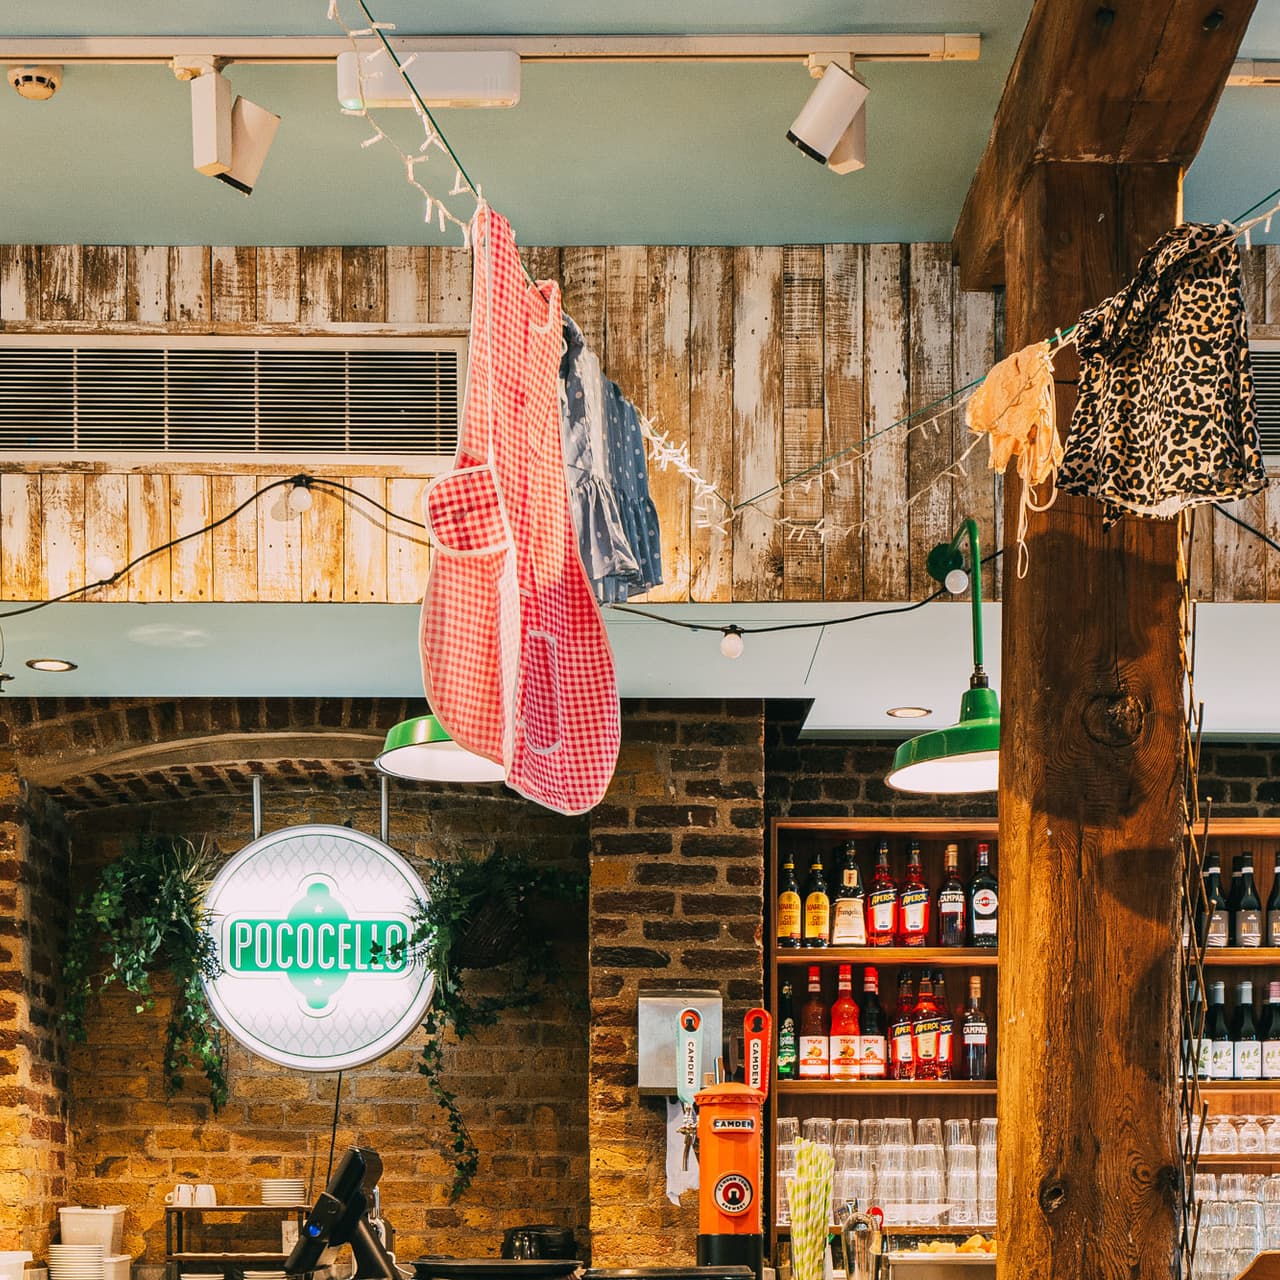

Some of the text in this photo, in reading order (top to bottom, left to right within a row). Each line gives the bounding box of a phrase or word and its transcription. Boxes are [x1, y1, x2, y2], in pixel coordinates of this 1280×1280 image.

[871, 893, 895, 905] APEROL
[902, 893, 926, 905] APEROL
[235, 922, 403, 971] POCOCELLO
[894, 1025, 911, 1036] APER
[915, 1022, 939, 1034] APEROL
[687, 1041, 695, 1085] CAMDEN
[714, 1120, 753, 1128] CAMDEN
